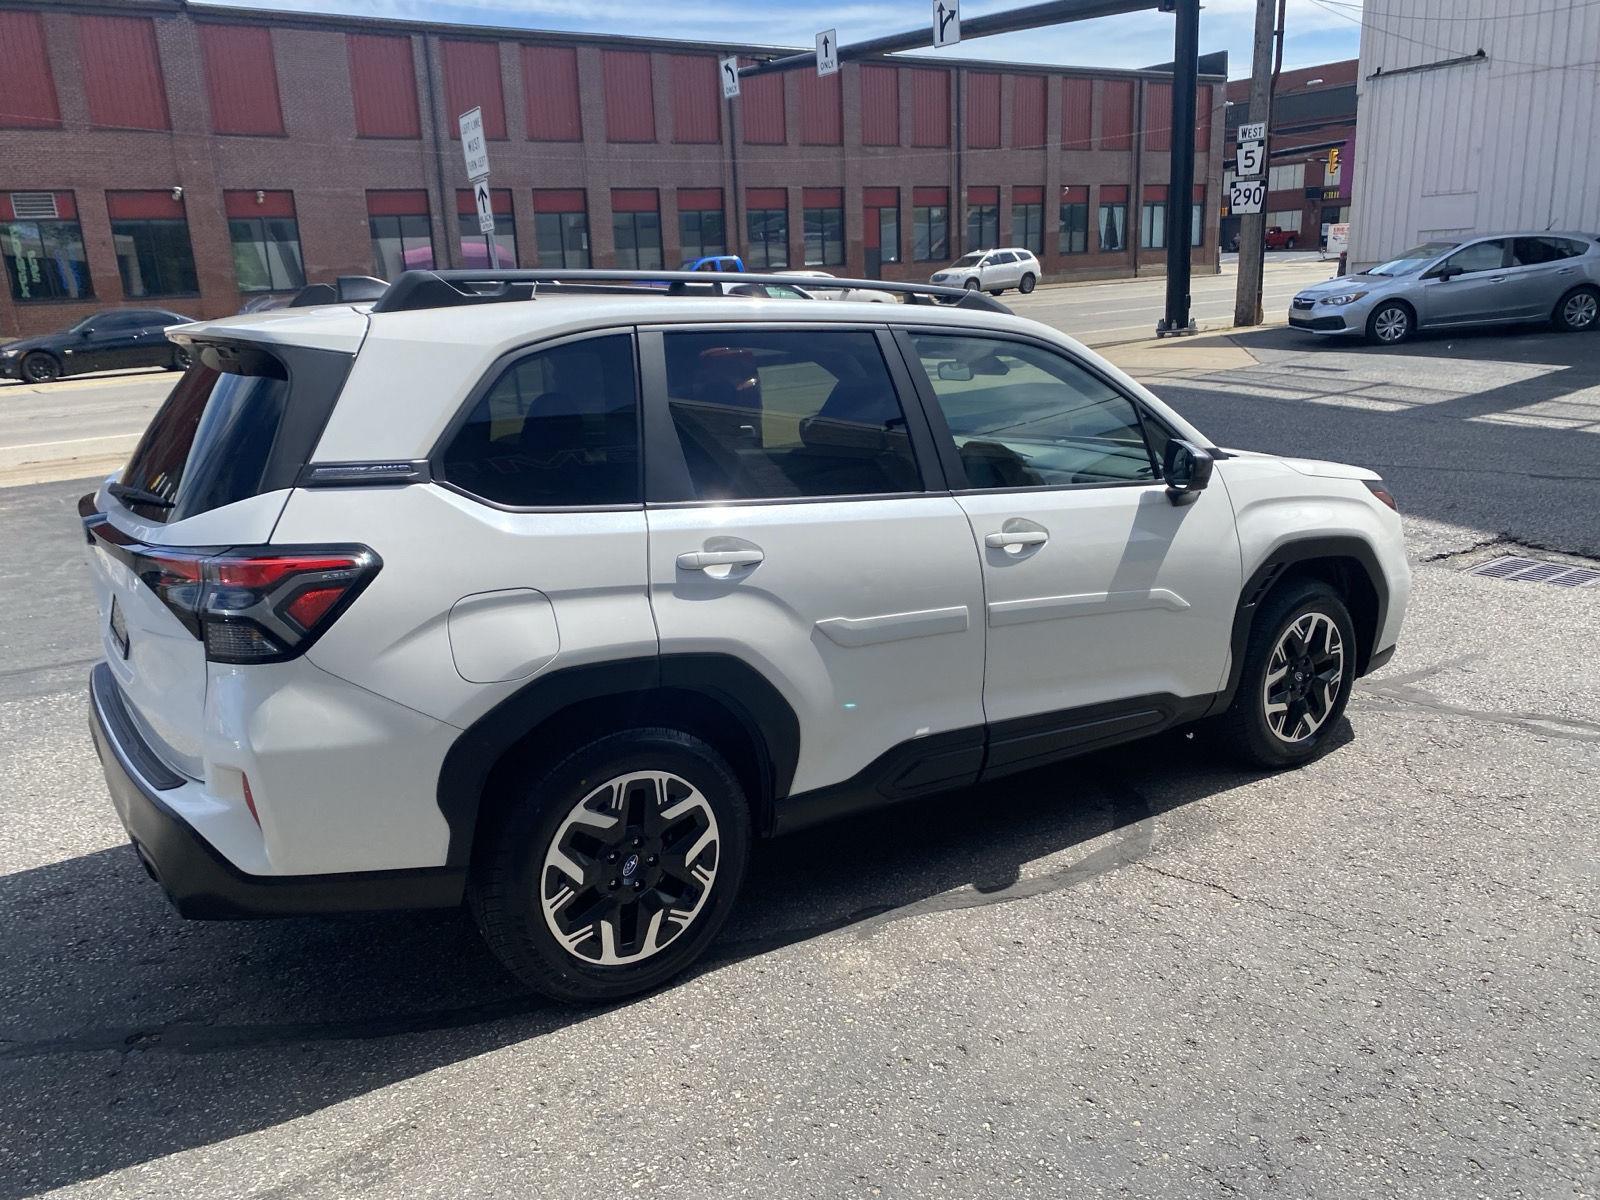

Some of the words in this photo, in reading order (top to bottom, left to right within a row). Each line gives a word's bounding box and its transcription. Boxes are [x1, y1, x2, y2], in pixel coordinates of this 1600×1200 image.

[820, 60, 834, 71] ONLY
[725, 86, 737, 95] ONLY
[1241, 126, 1263, 139] WEST
[1243, 149, 1256, 169] 5
[1232, 186, 1262, 207] 290
